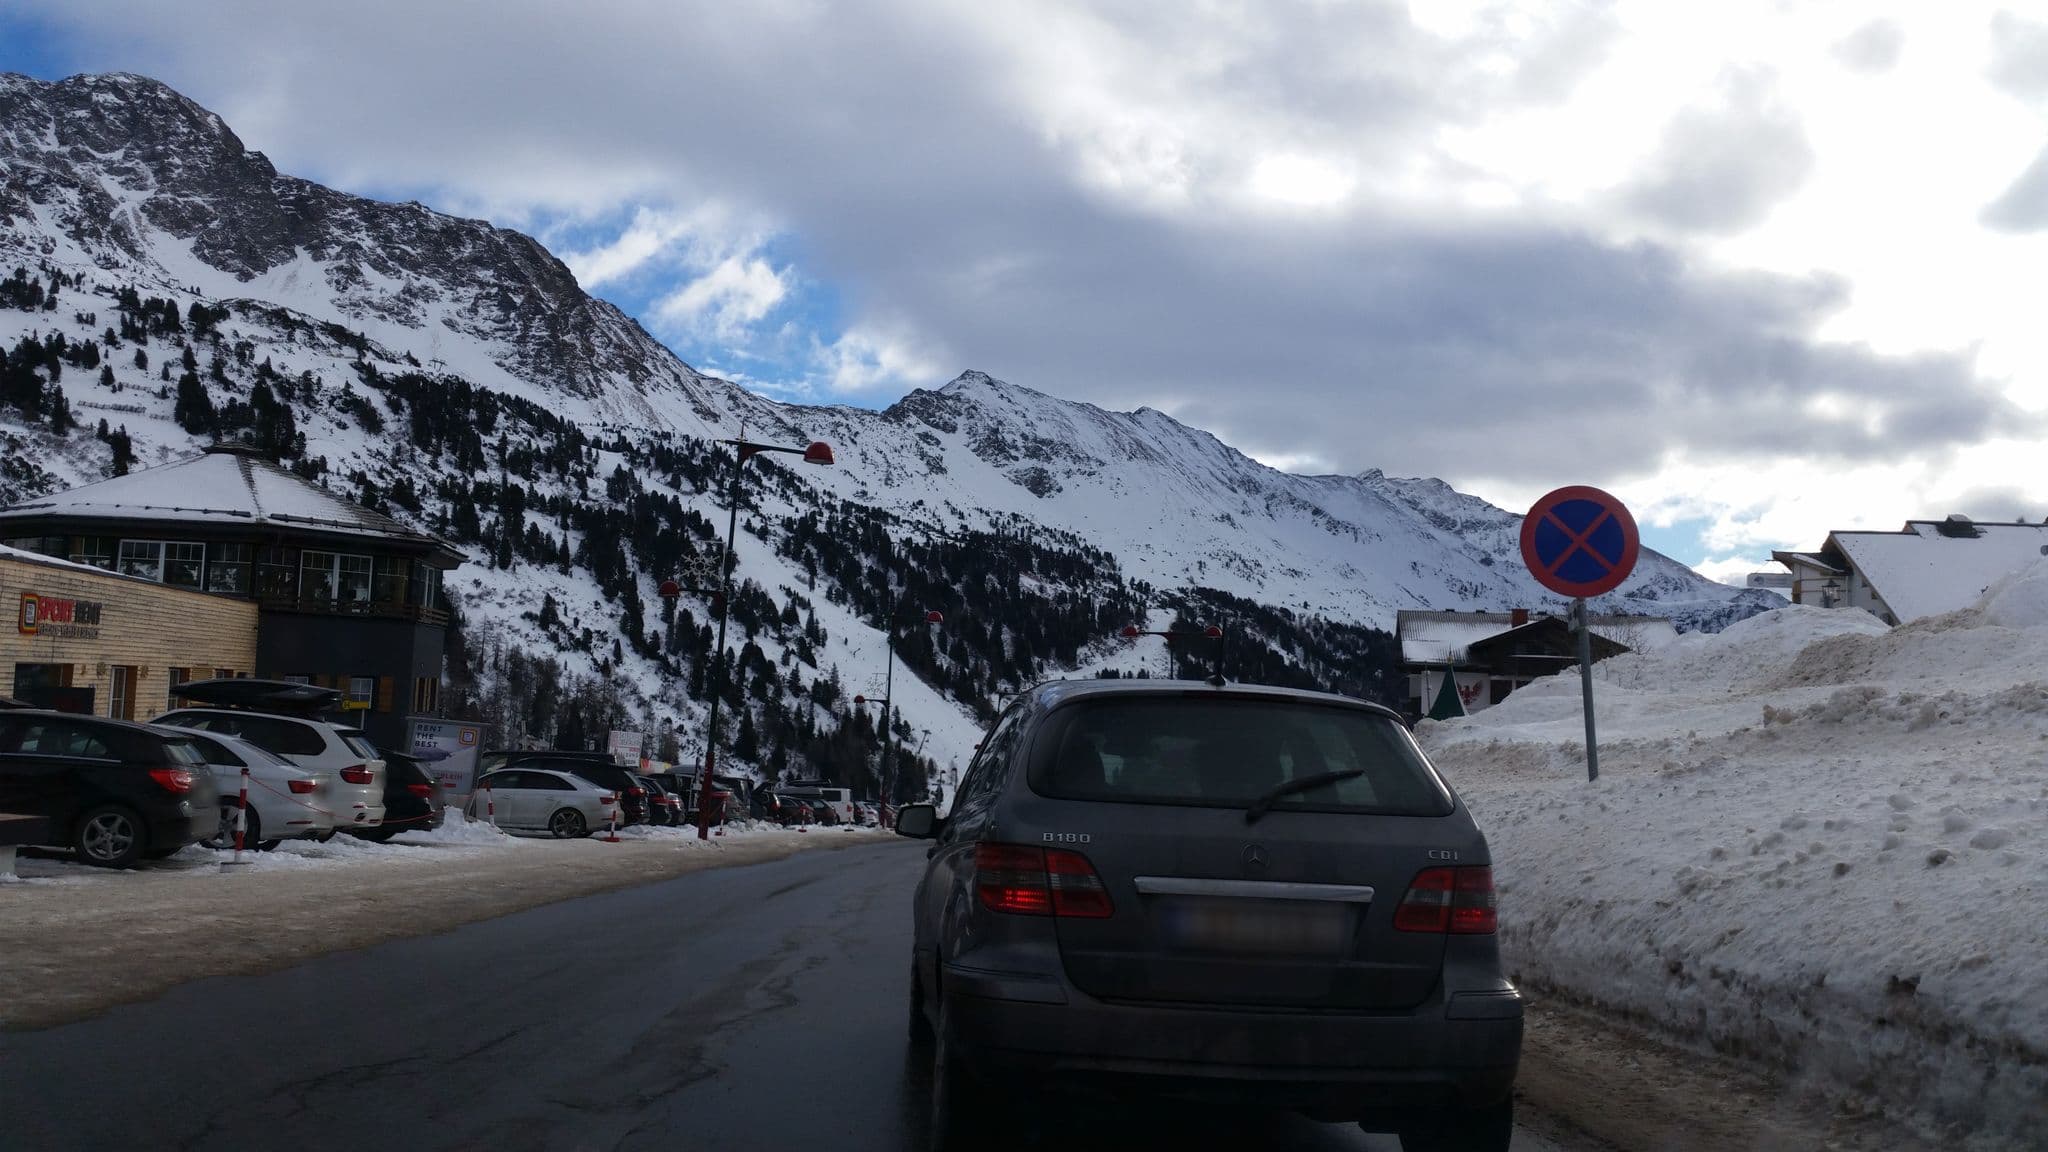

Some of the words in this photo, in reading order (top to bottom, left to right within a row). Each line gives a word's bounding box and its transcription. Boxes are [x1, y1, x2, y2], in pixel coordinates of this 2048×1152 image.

[38, 596, 74, 622] SPORT
[416, 724, 443, 733] RENT
[416, 732, 435, 740] THE
[415, 740, 438, 748] BEST
[1043, 832, 1090, 843] B180
[1428, 849, 1458, 860] CDI
